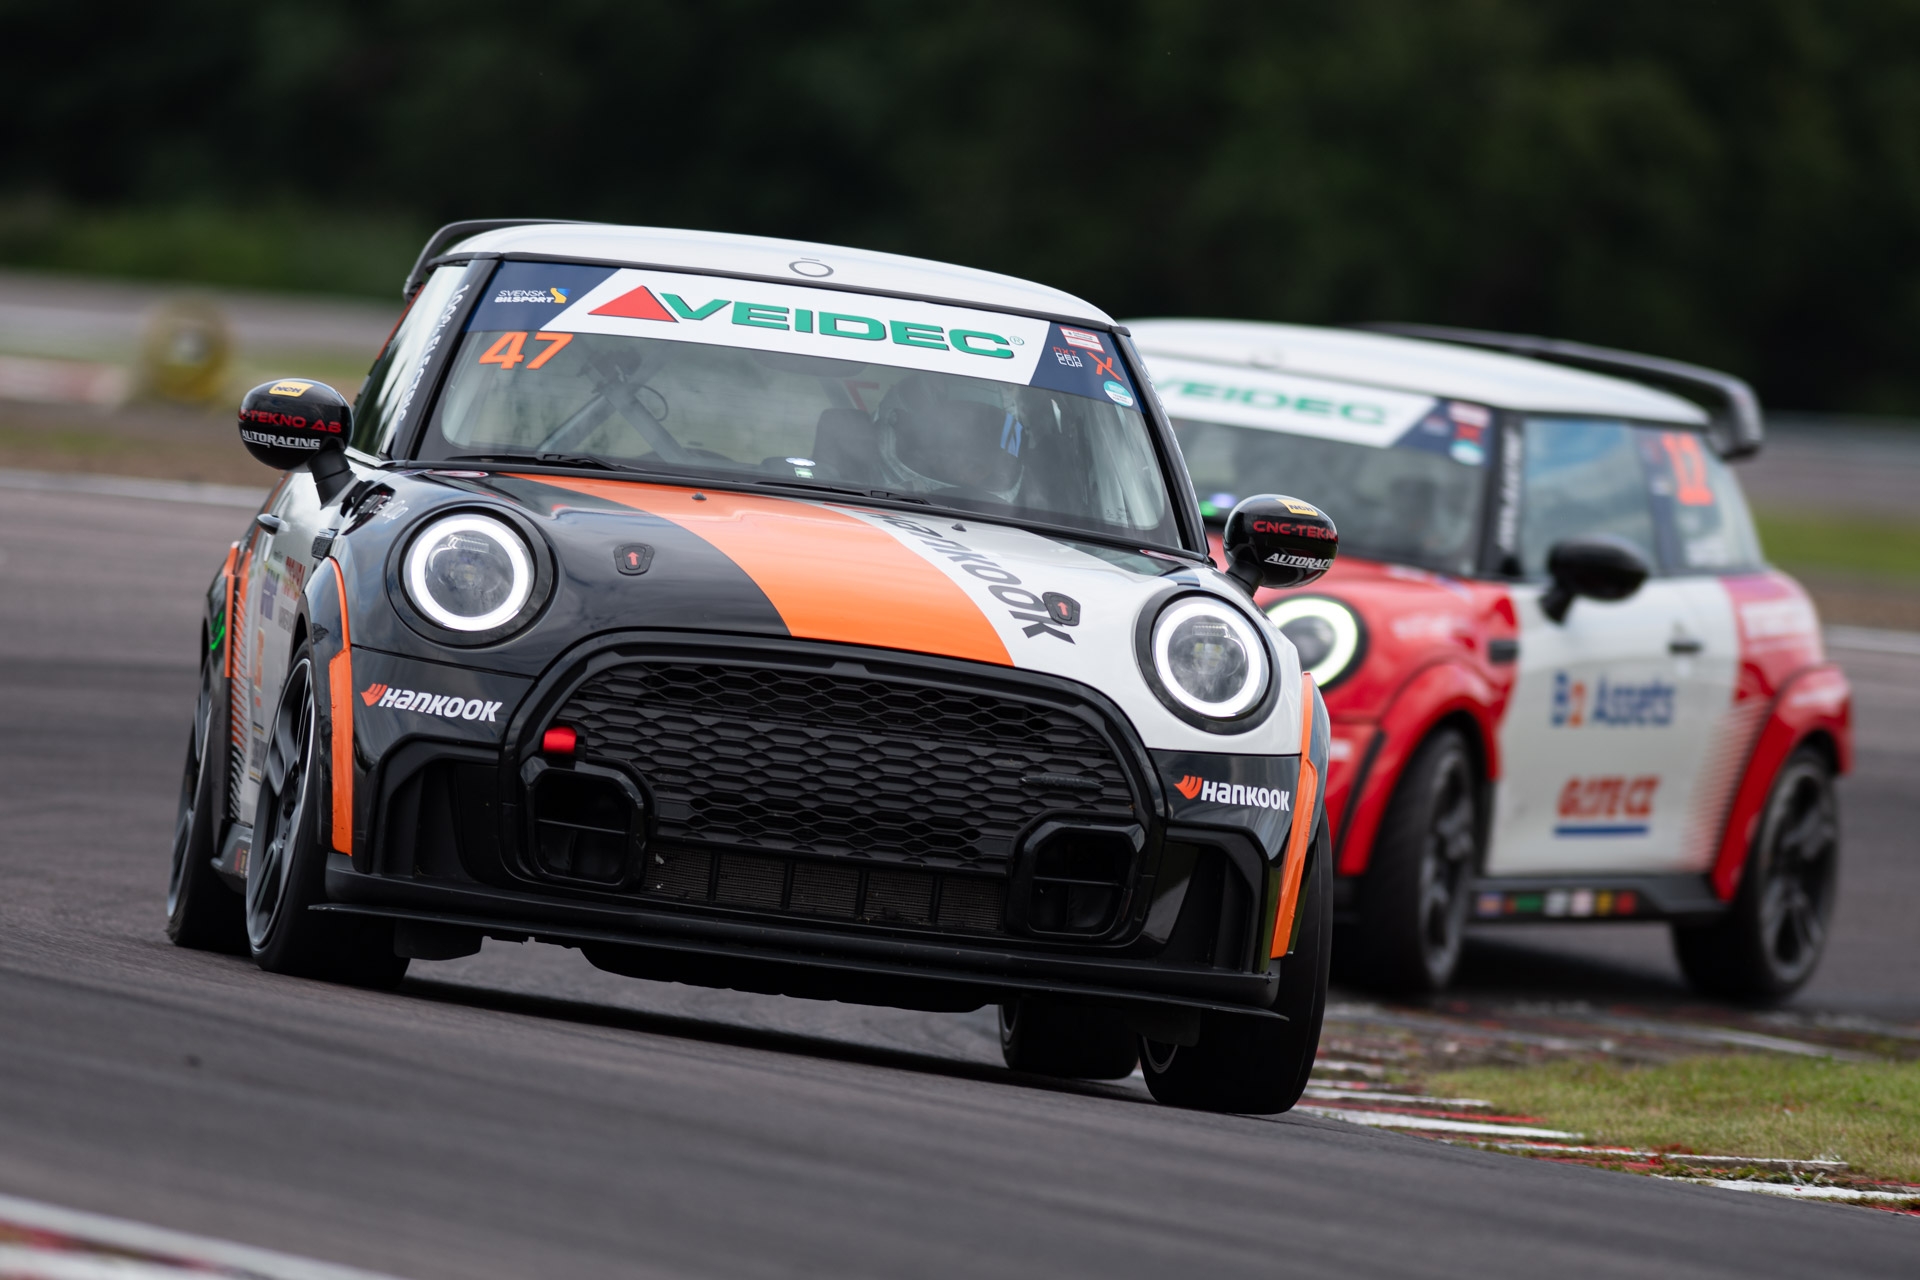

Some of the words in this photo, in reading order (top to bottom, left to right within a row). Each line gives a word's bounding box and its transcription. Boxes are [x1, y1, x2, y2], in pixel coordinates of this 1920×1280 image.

[498, 289, 546, 297] SVENSK
[478, 331, 574, 370] 47
[311, 419, 342, 433] AB
[242, 429, 320, 448] AUTORACING
[1253, 520, 1338, 542] CNC-TEKN
